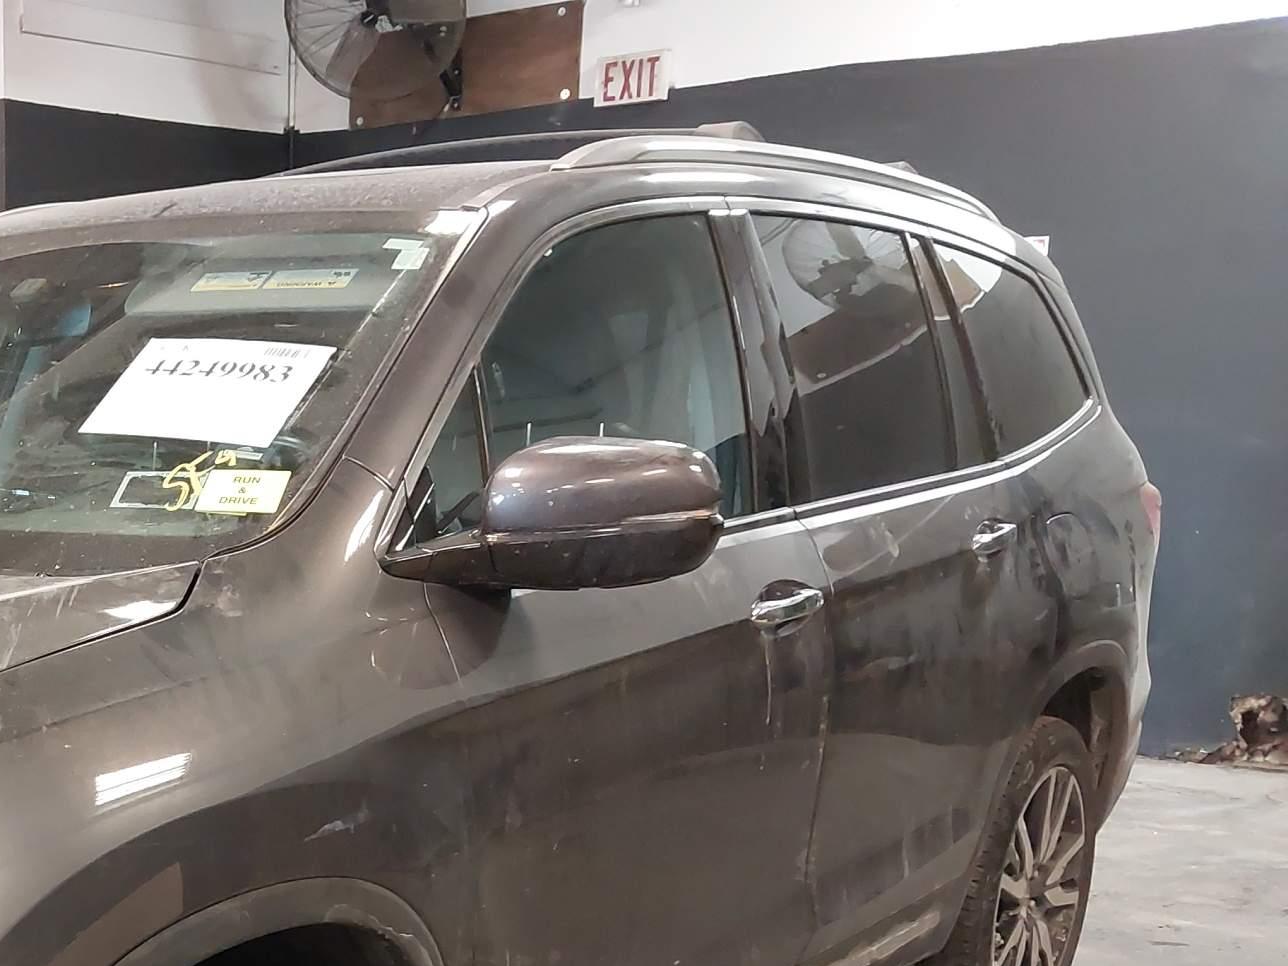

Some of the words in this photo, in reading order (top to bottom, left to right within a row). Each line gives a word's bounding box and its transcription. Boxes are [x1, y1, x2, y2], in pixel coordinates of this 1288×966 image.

[603, 56, 661, 102] EXIT
[145, 359, 294, 383] 44249983
[233, 476, 261, 484] RUN
[238, 486, 247, 494] &
[218, 496, 259, 505] DRIVE
